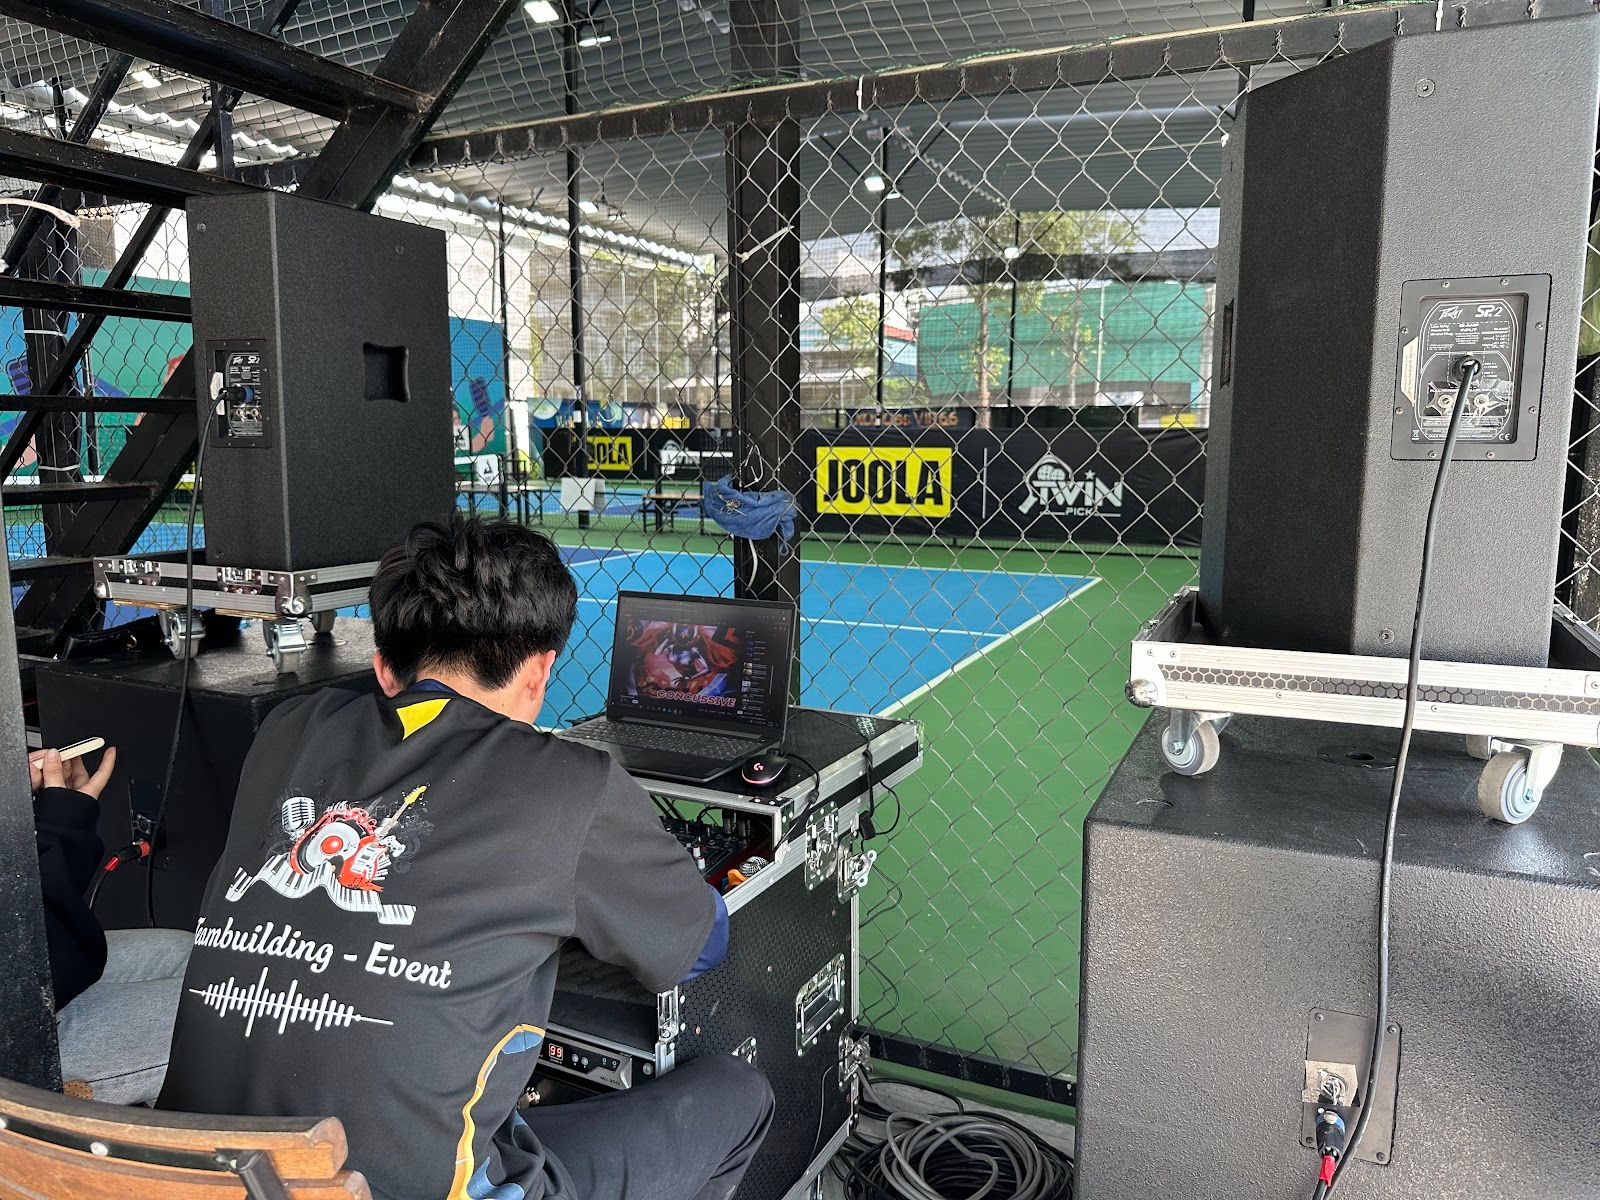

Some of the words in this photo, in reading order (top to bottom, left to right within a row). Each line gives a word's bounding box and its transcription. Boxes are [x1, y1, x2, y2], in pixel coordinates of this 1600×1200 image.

[824, 459, 944, 506] JOOLA
[656, 689, 737, 708] CONCUSSIVE
[365, 941, 452, 989] Event
